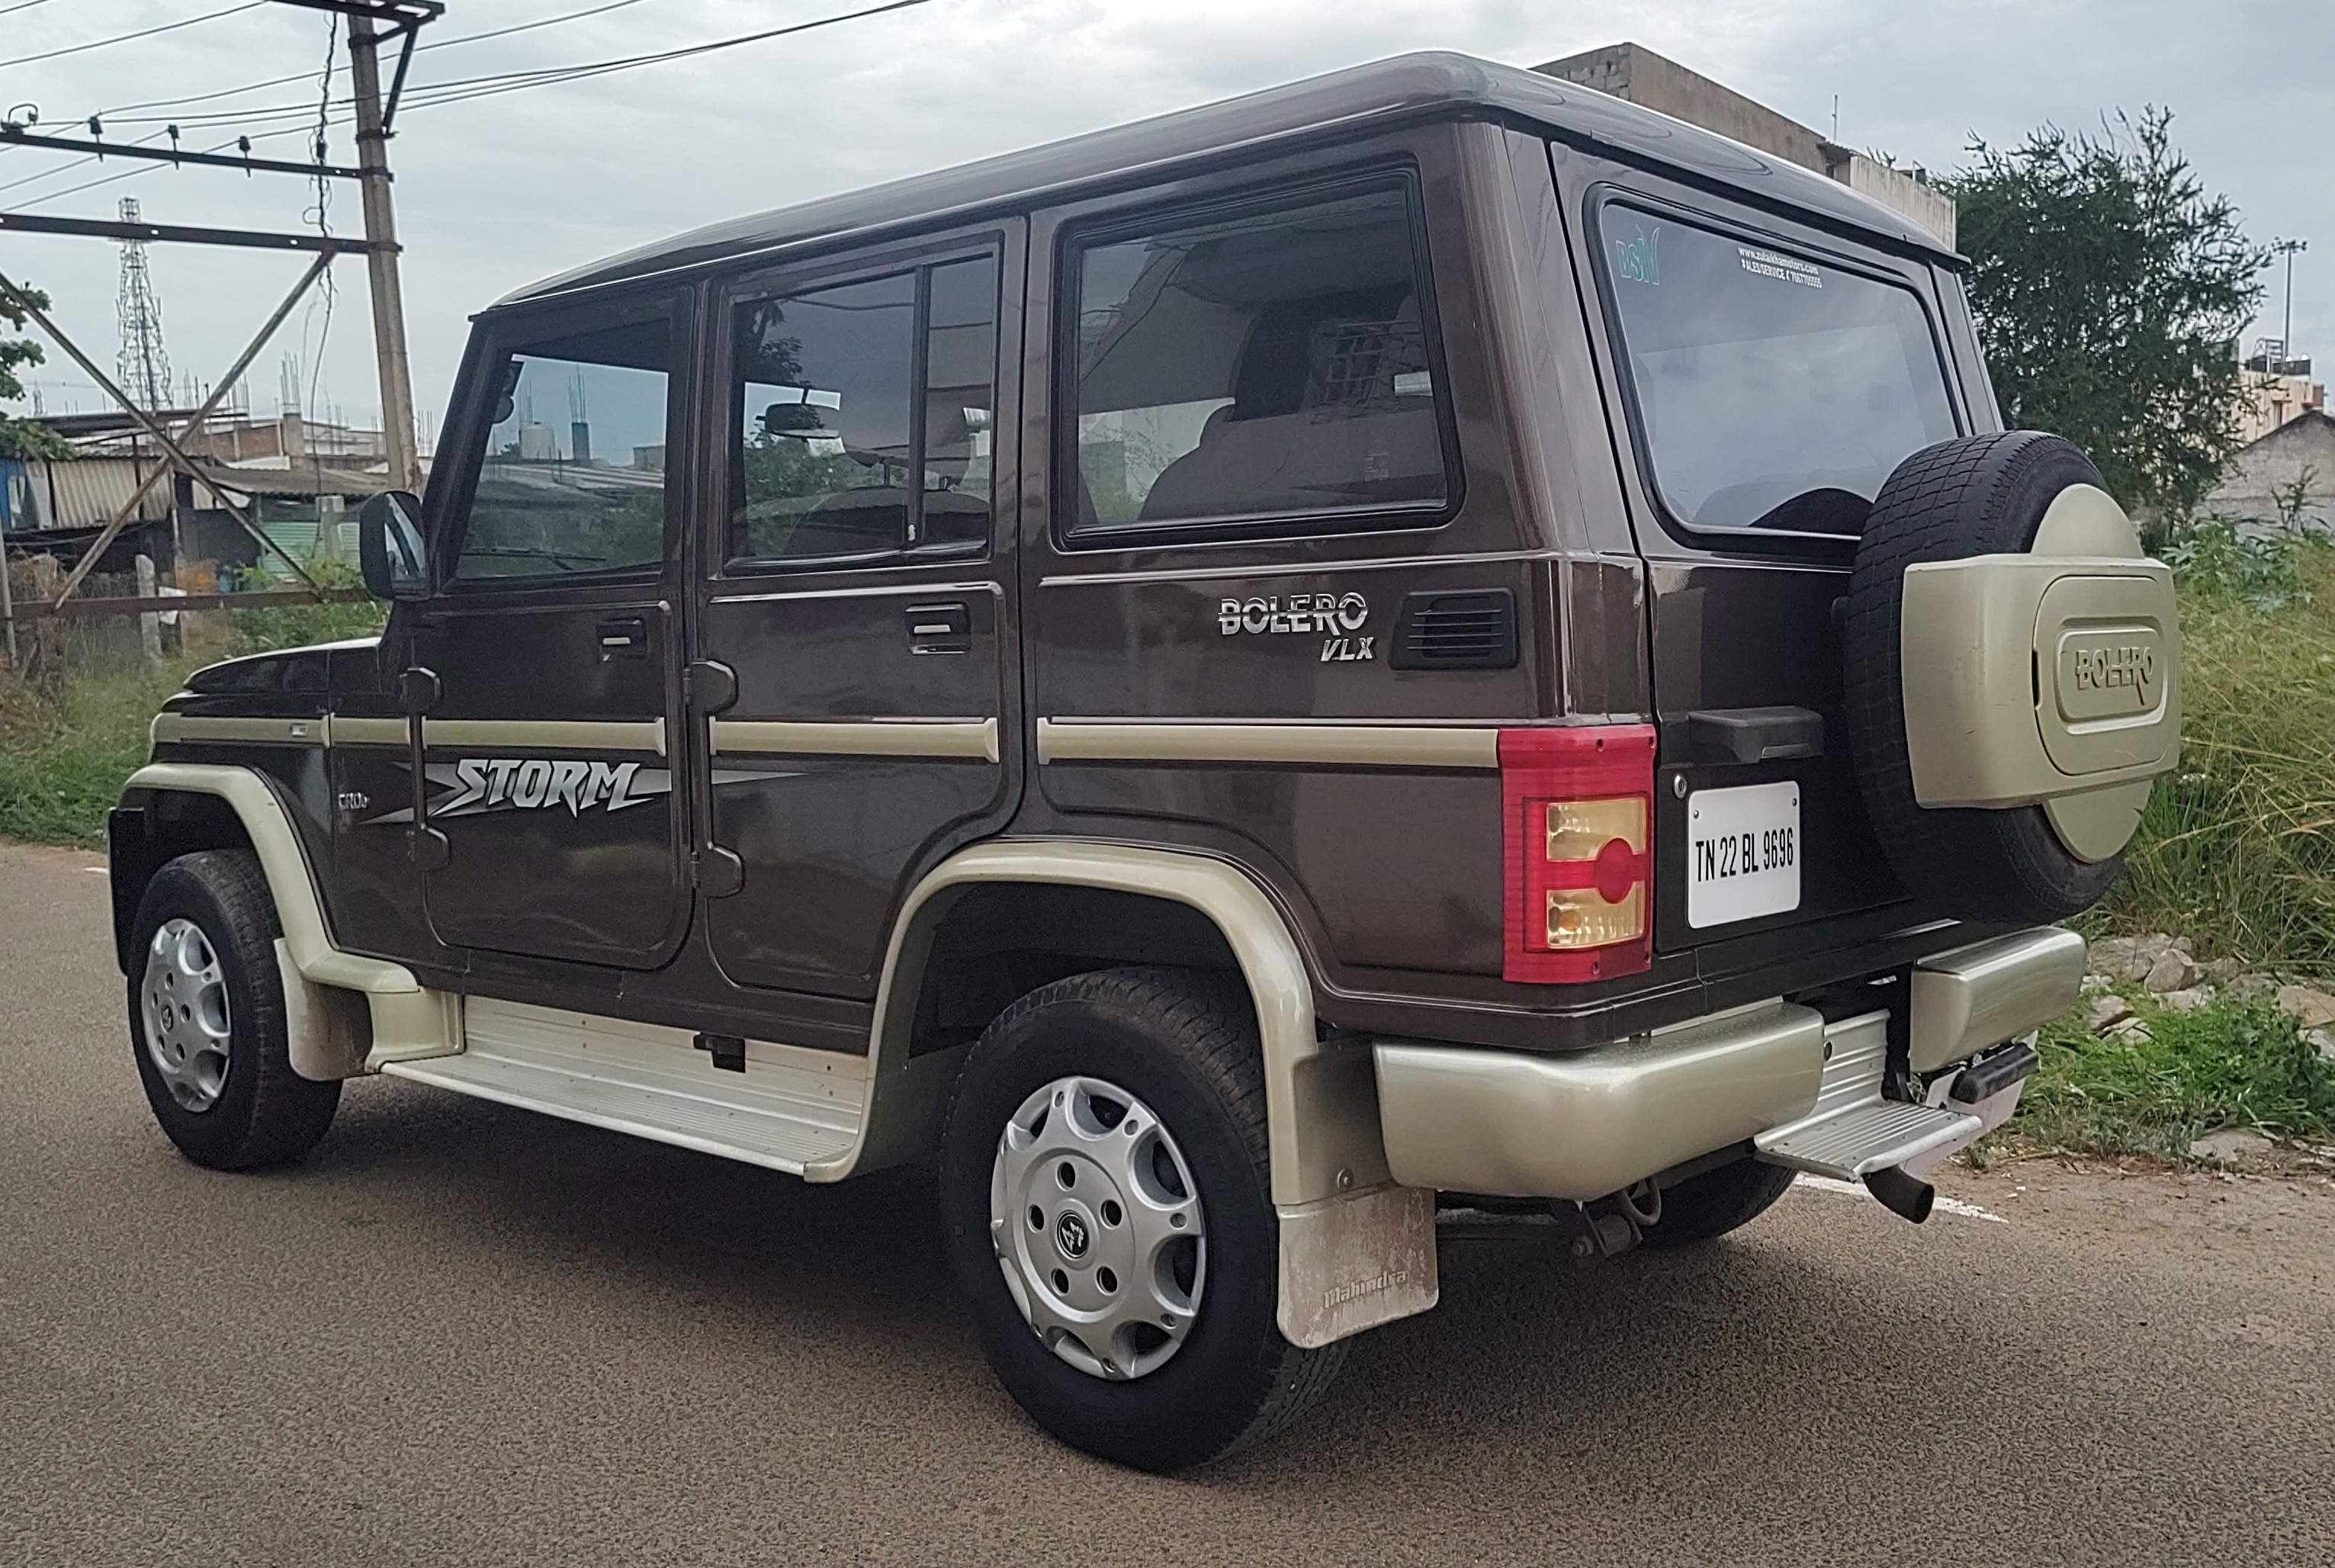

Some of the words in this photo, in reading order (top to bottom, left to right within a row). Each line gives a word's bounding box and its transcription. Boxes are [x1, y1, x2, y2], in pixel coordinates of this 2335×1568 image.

[1218, 592, 1369, 636] BOLERO
[1320, 637, 1374, 662] VLX
[2075, 646, 2154, 706] BOLERO
[429, 758, 655, 819] STORM
[1695, 839, 1715, 882] TN
[1720, 836, 1737, 878] 22
[1742, 833, 1759, 875] BL
[1763, 827, 1794, 870] 9696
